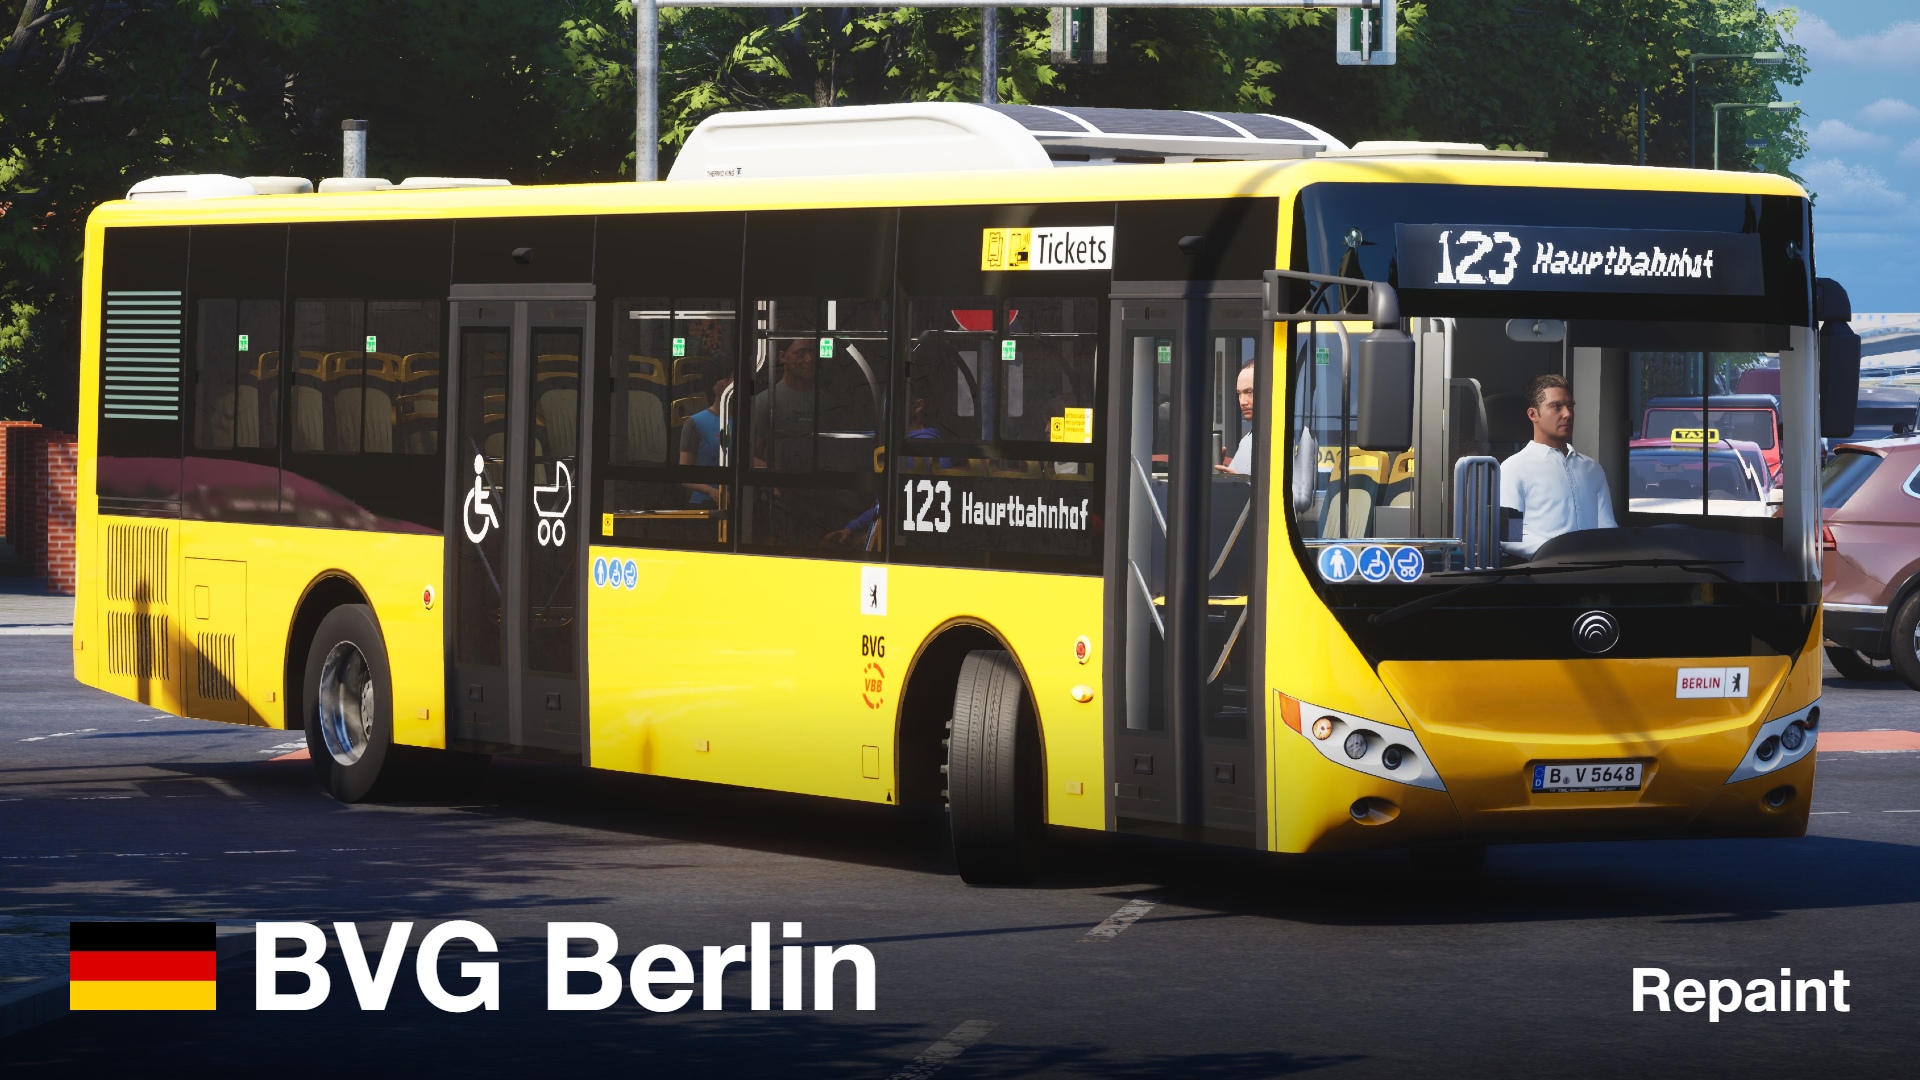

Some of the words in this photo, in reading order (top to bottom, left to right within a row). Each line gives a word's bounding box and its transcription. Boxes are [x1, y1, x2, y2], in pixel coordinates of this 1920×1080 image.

[1038, 231, 1106, 264] Tickets
[1435, 230, 1521, 285] 123
[1532, 241, 1714, 278] Hauptbahnhof
[903, 479, 952, 533] 123
[961, 491, 1089, 531] Hauptbahnhof
[862, 634, 885, 658] BVG
[865, 678, 882, 693] VBB
[1681, 677, 1721, 689] BERLIN
[1535, 779, 1542, 787] D
[1549, 768, 1561, 784] B
[1576, 767, 1587, 783] V
[1591, 766, 1635, 783] 5648
